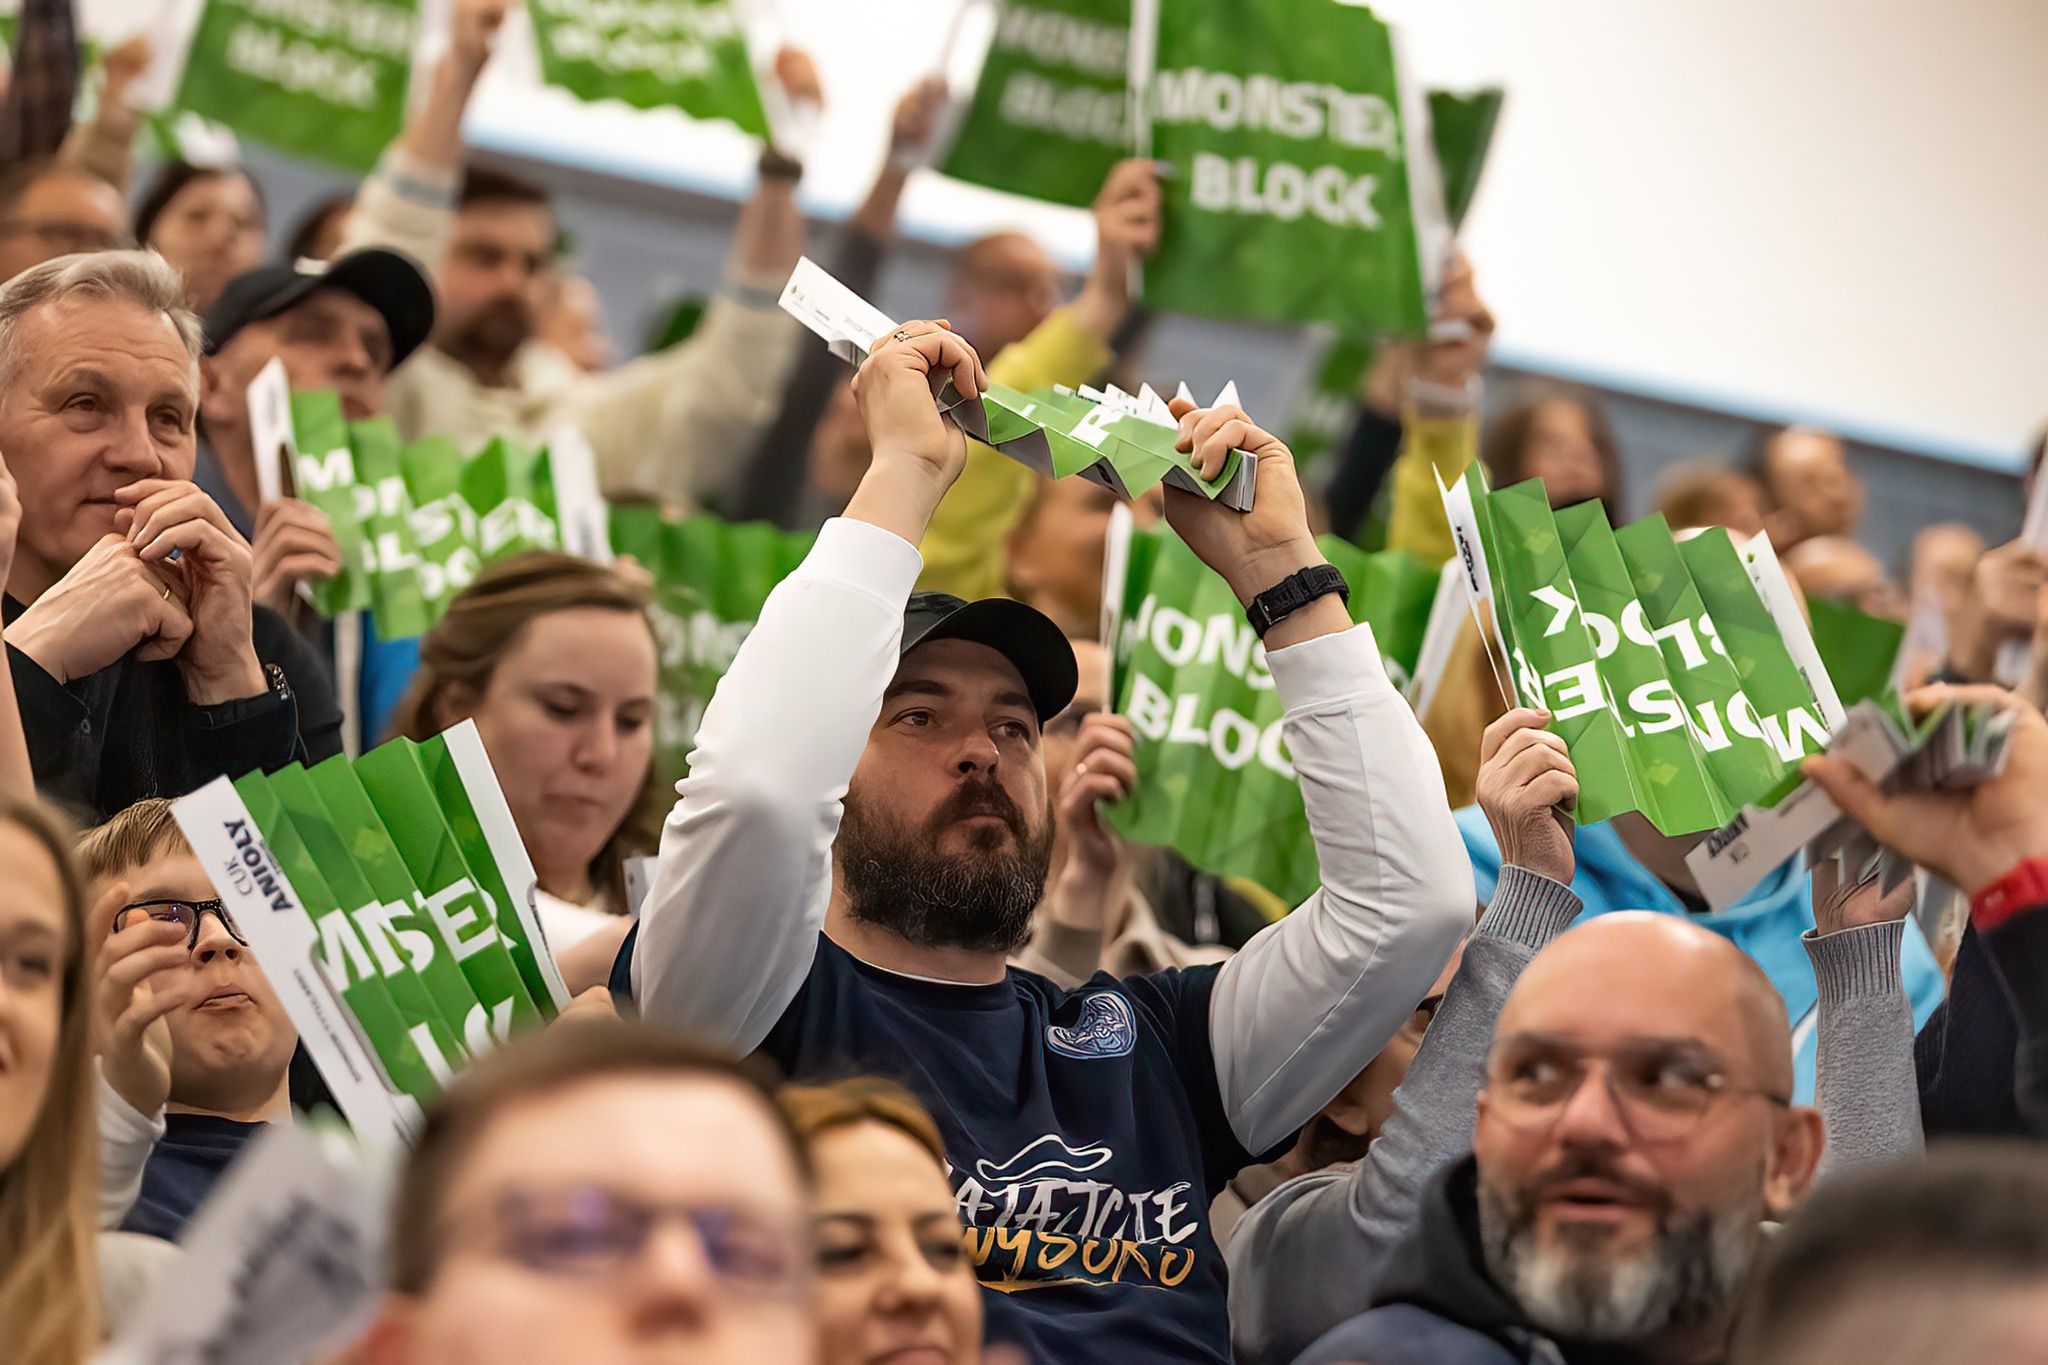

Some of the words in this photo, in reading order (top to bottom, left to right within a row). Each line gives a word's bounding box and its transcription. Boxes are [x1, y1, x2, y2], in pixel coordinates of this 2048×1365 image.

[1191, 152, 1381, 230] BLOCK
[1119, 593, 1285, 690] MONS
[1126, 673, 1298, 780] BLOC
[224, 855, 253, 896] CUK
[946, 1158, 1199, 1245] ATAJCIE
